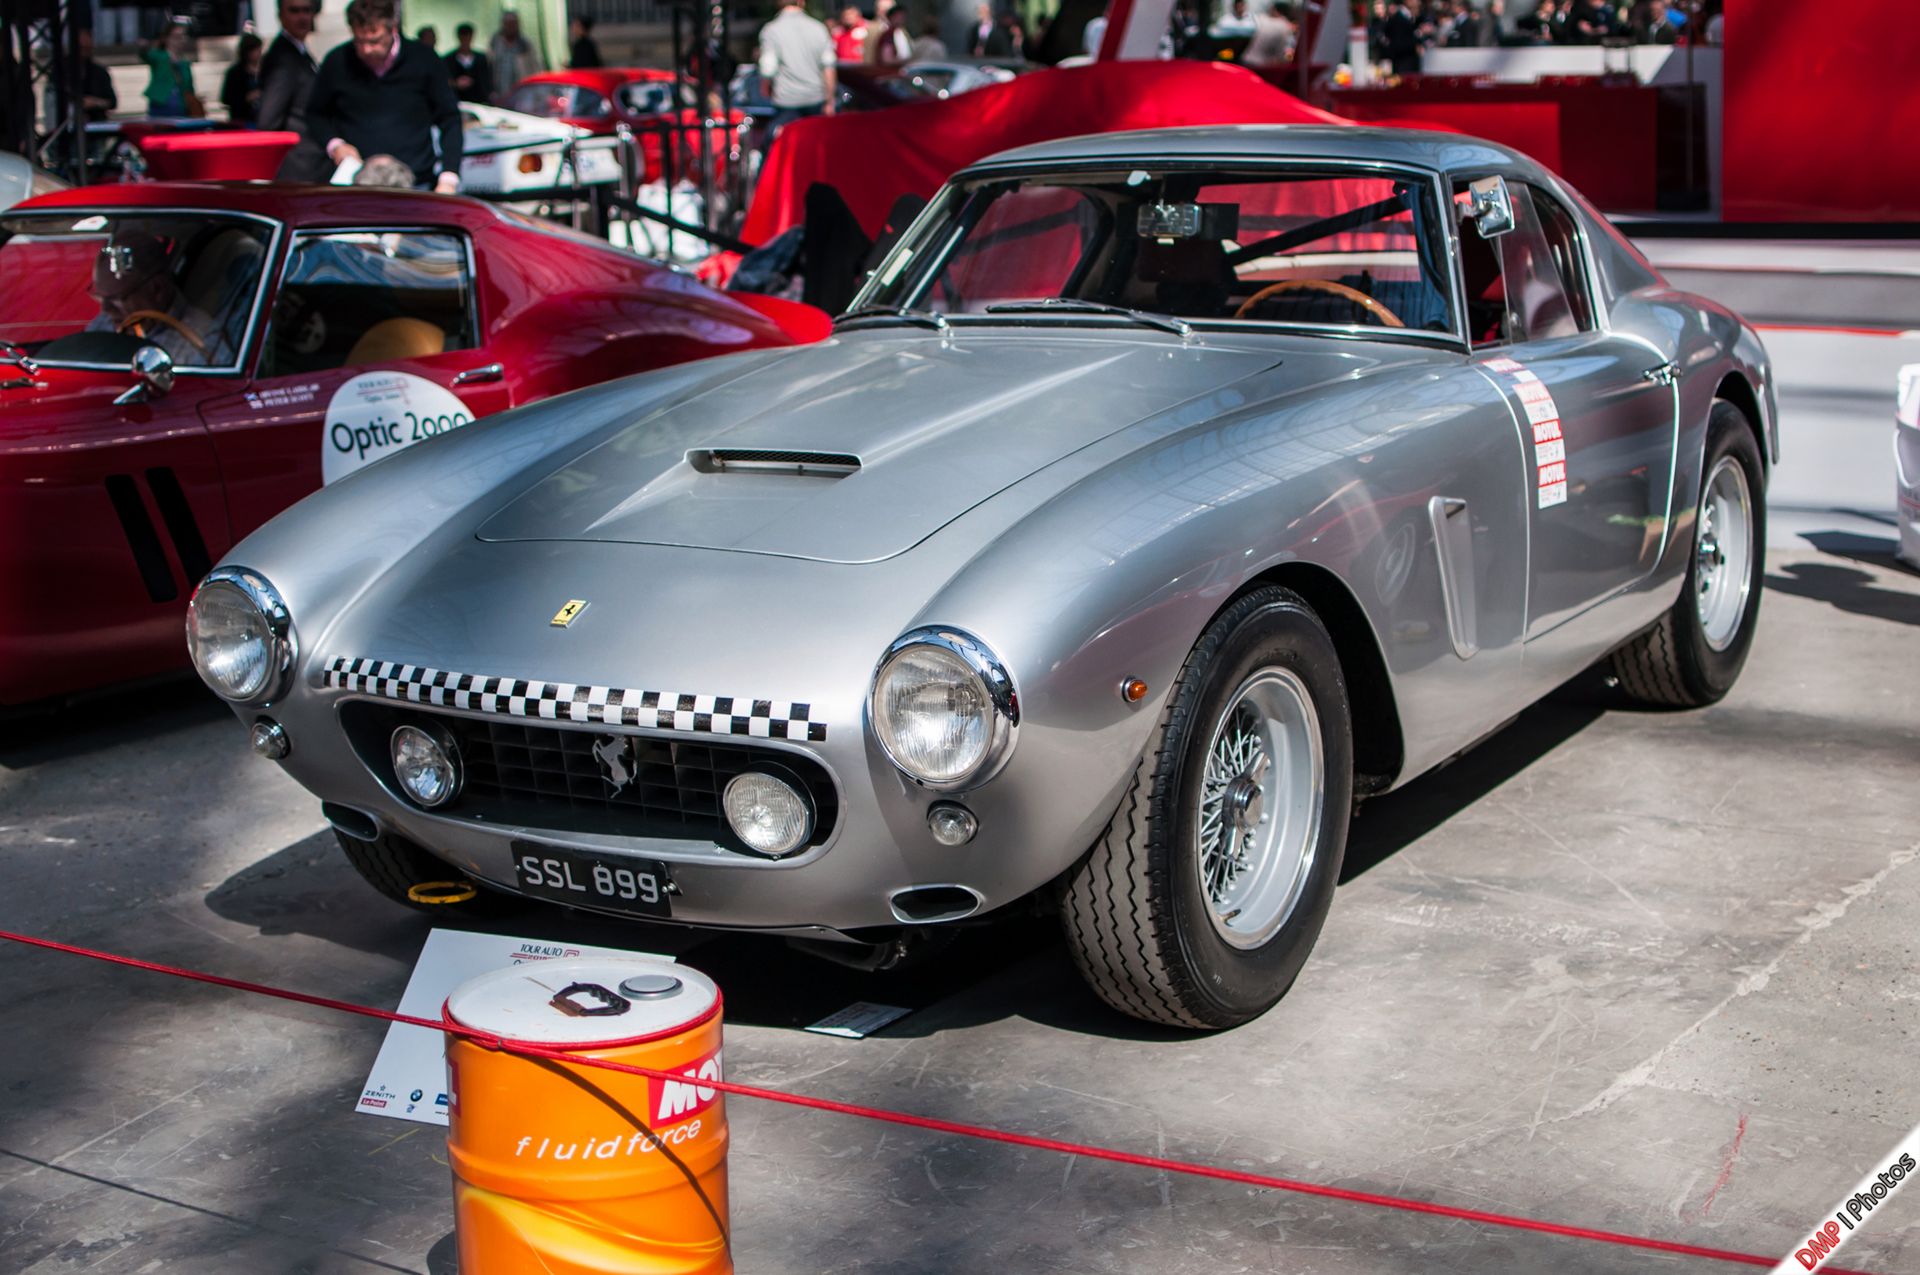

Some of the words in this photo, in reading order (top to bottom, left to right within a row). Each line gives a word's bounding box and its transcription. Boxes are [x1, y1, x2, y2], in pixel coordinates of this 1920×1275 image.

[331, 416, 402, 460] Optic
[1534, 420, 1562, 443] MOTUL
[1539, 462, 1566, 486] MOTUL
[521, 856, 587, 892] SSL
[592, 866, 659, 904] 899
[520, 944, 541, 954] TOUR
[541, 947, 563, 957] AUTO
[364, 1090, 396, 1100] ZENITH
